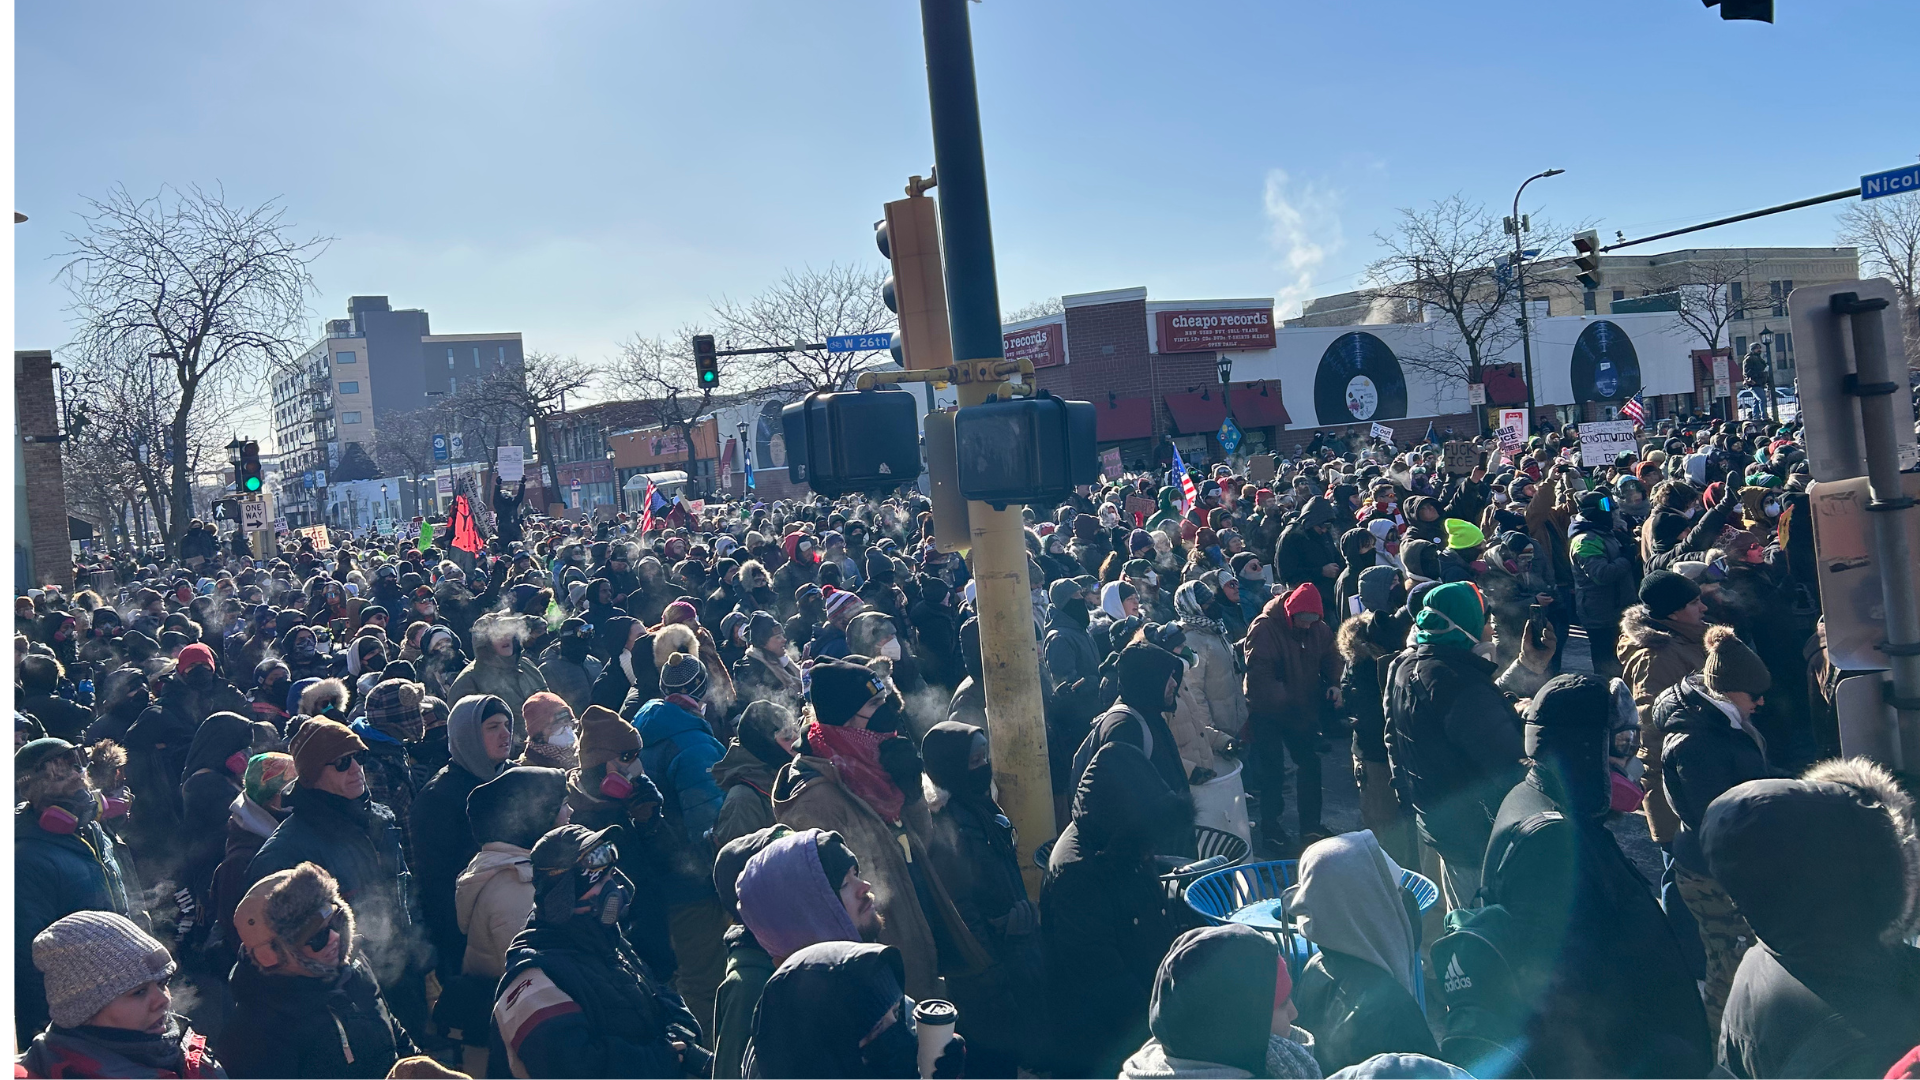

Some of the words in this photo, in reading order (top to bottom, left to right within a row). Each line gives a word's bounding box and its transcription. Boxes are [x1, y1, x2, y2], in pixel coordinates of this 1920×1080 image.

[1172, 315, 1218, 329] cheapo
[1220, 312, 1268, 326] records
[844, 339, 853, 348] W
[860, 337, 888, 347] 26th
[1010, 331, 1047, 348] records
[1497, 426, 1515, 436] KILLER
[1580, 425, 1593, 434] ICE
[1500, 433, 1517, 442] ICE
[1580, 433, 1636, 444] CONSTITUTION
[1444, 444, 1477, 456] FUCK
[1104, 452, 1119, 463] FUCK
[1448, 456, 1473, 466] ICE
[1106, 463, 1122, 477] ICE
[1444, 976, 1472, 992] adidas
